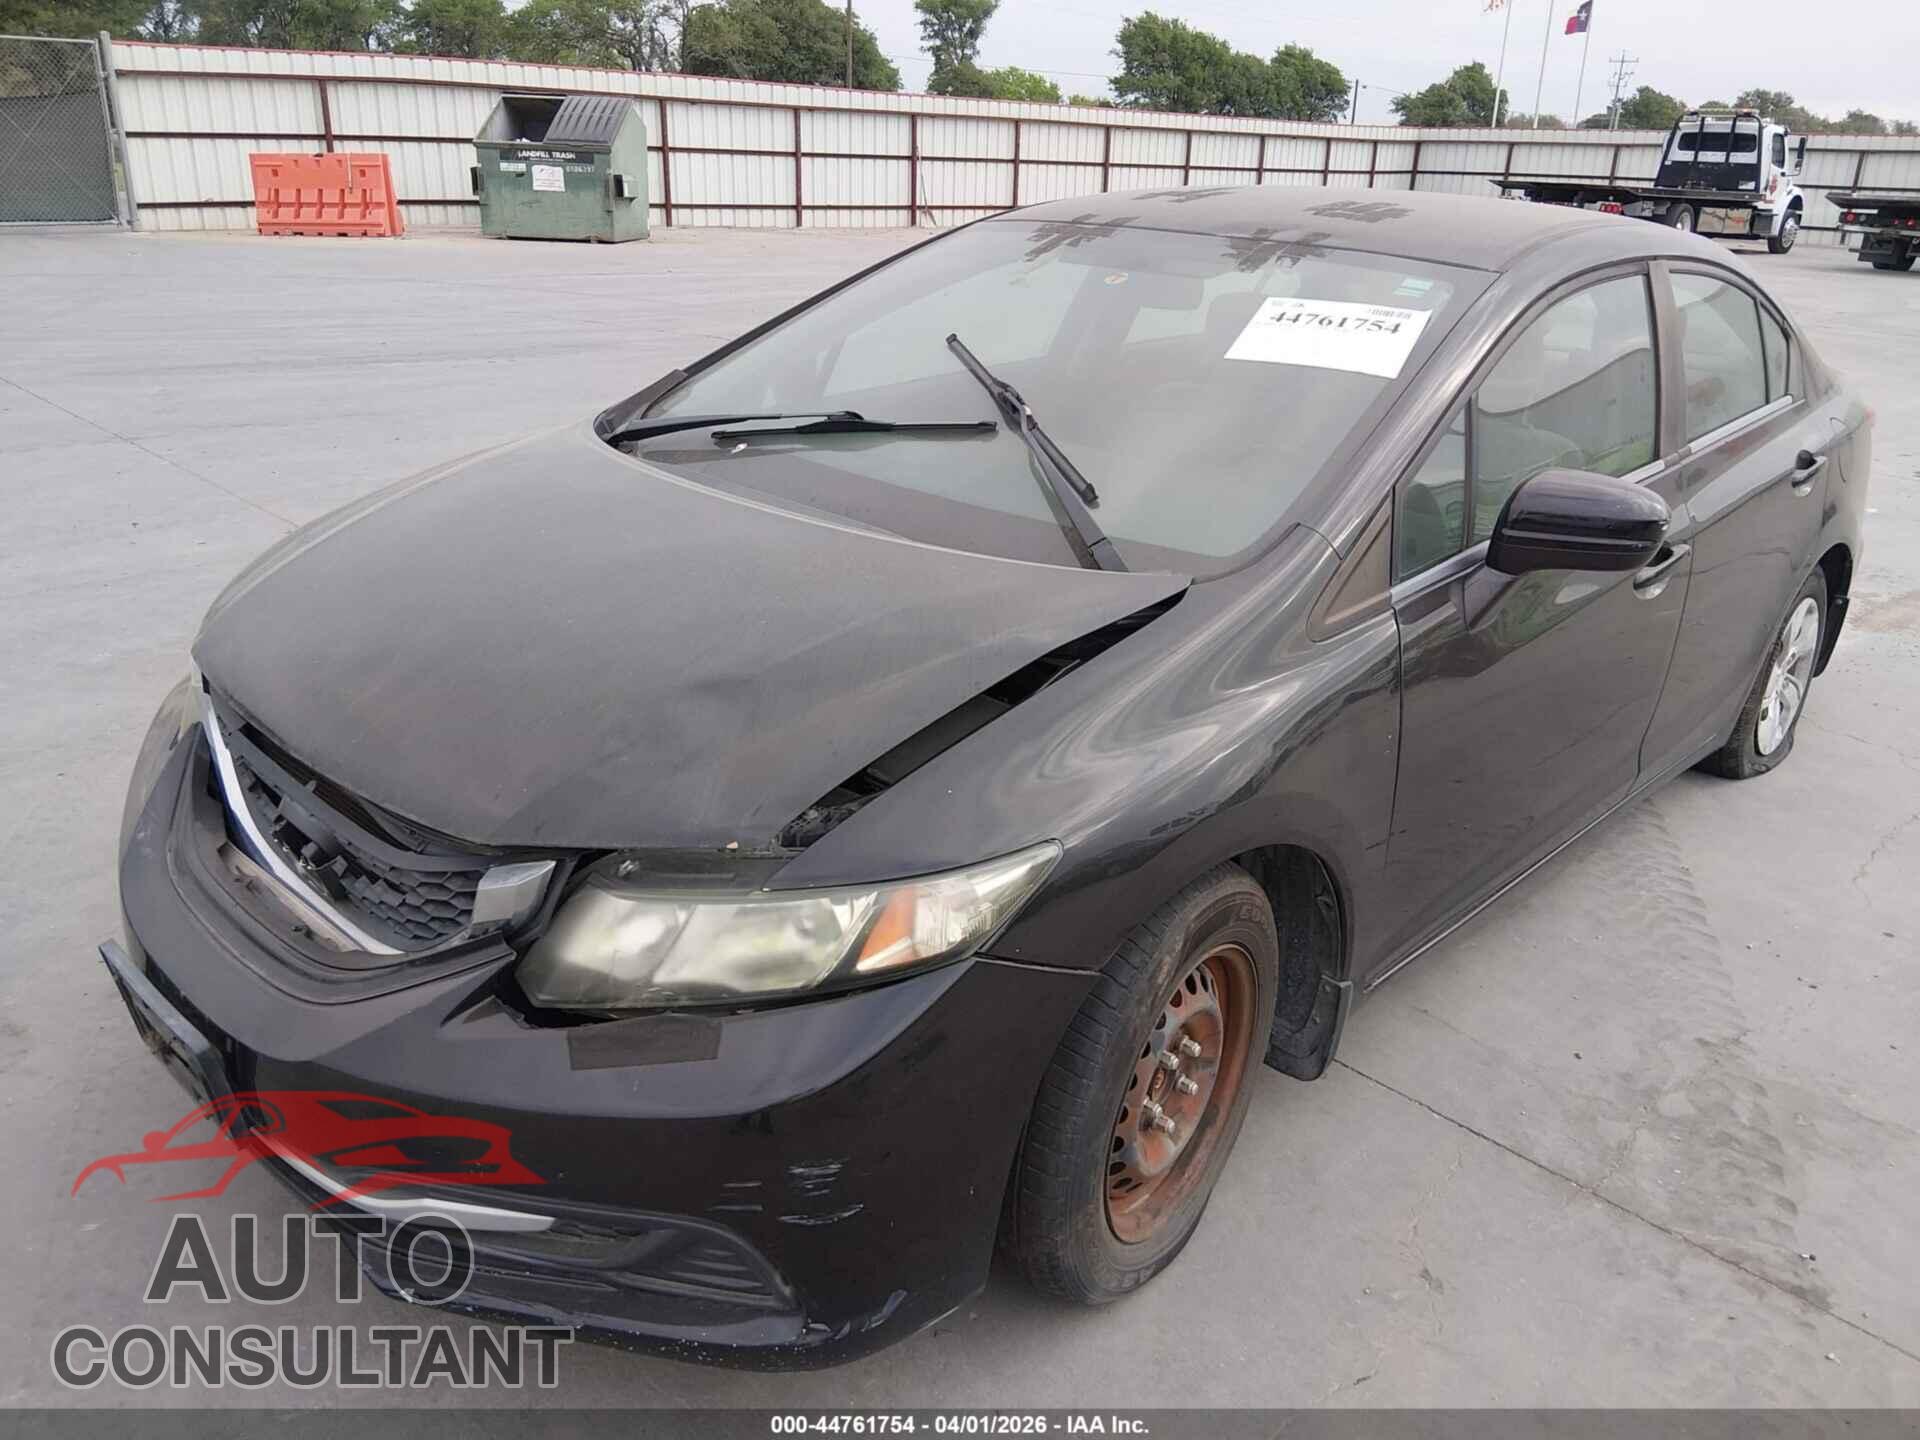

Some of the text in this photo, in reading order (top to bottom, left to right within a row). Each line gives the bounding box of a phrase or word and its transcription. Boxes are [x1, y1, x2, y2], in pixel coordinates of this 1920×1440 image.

[518, 150, 550, 158] LANDFILL
[551, 151, 576, 160] TRASH
[1269, 311, 1401, 334] 44761754
